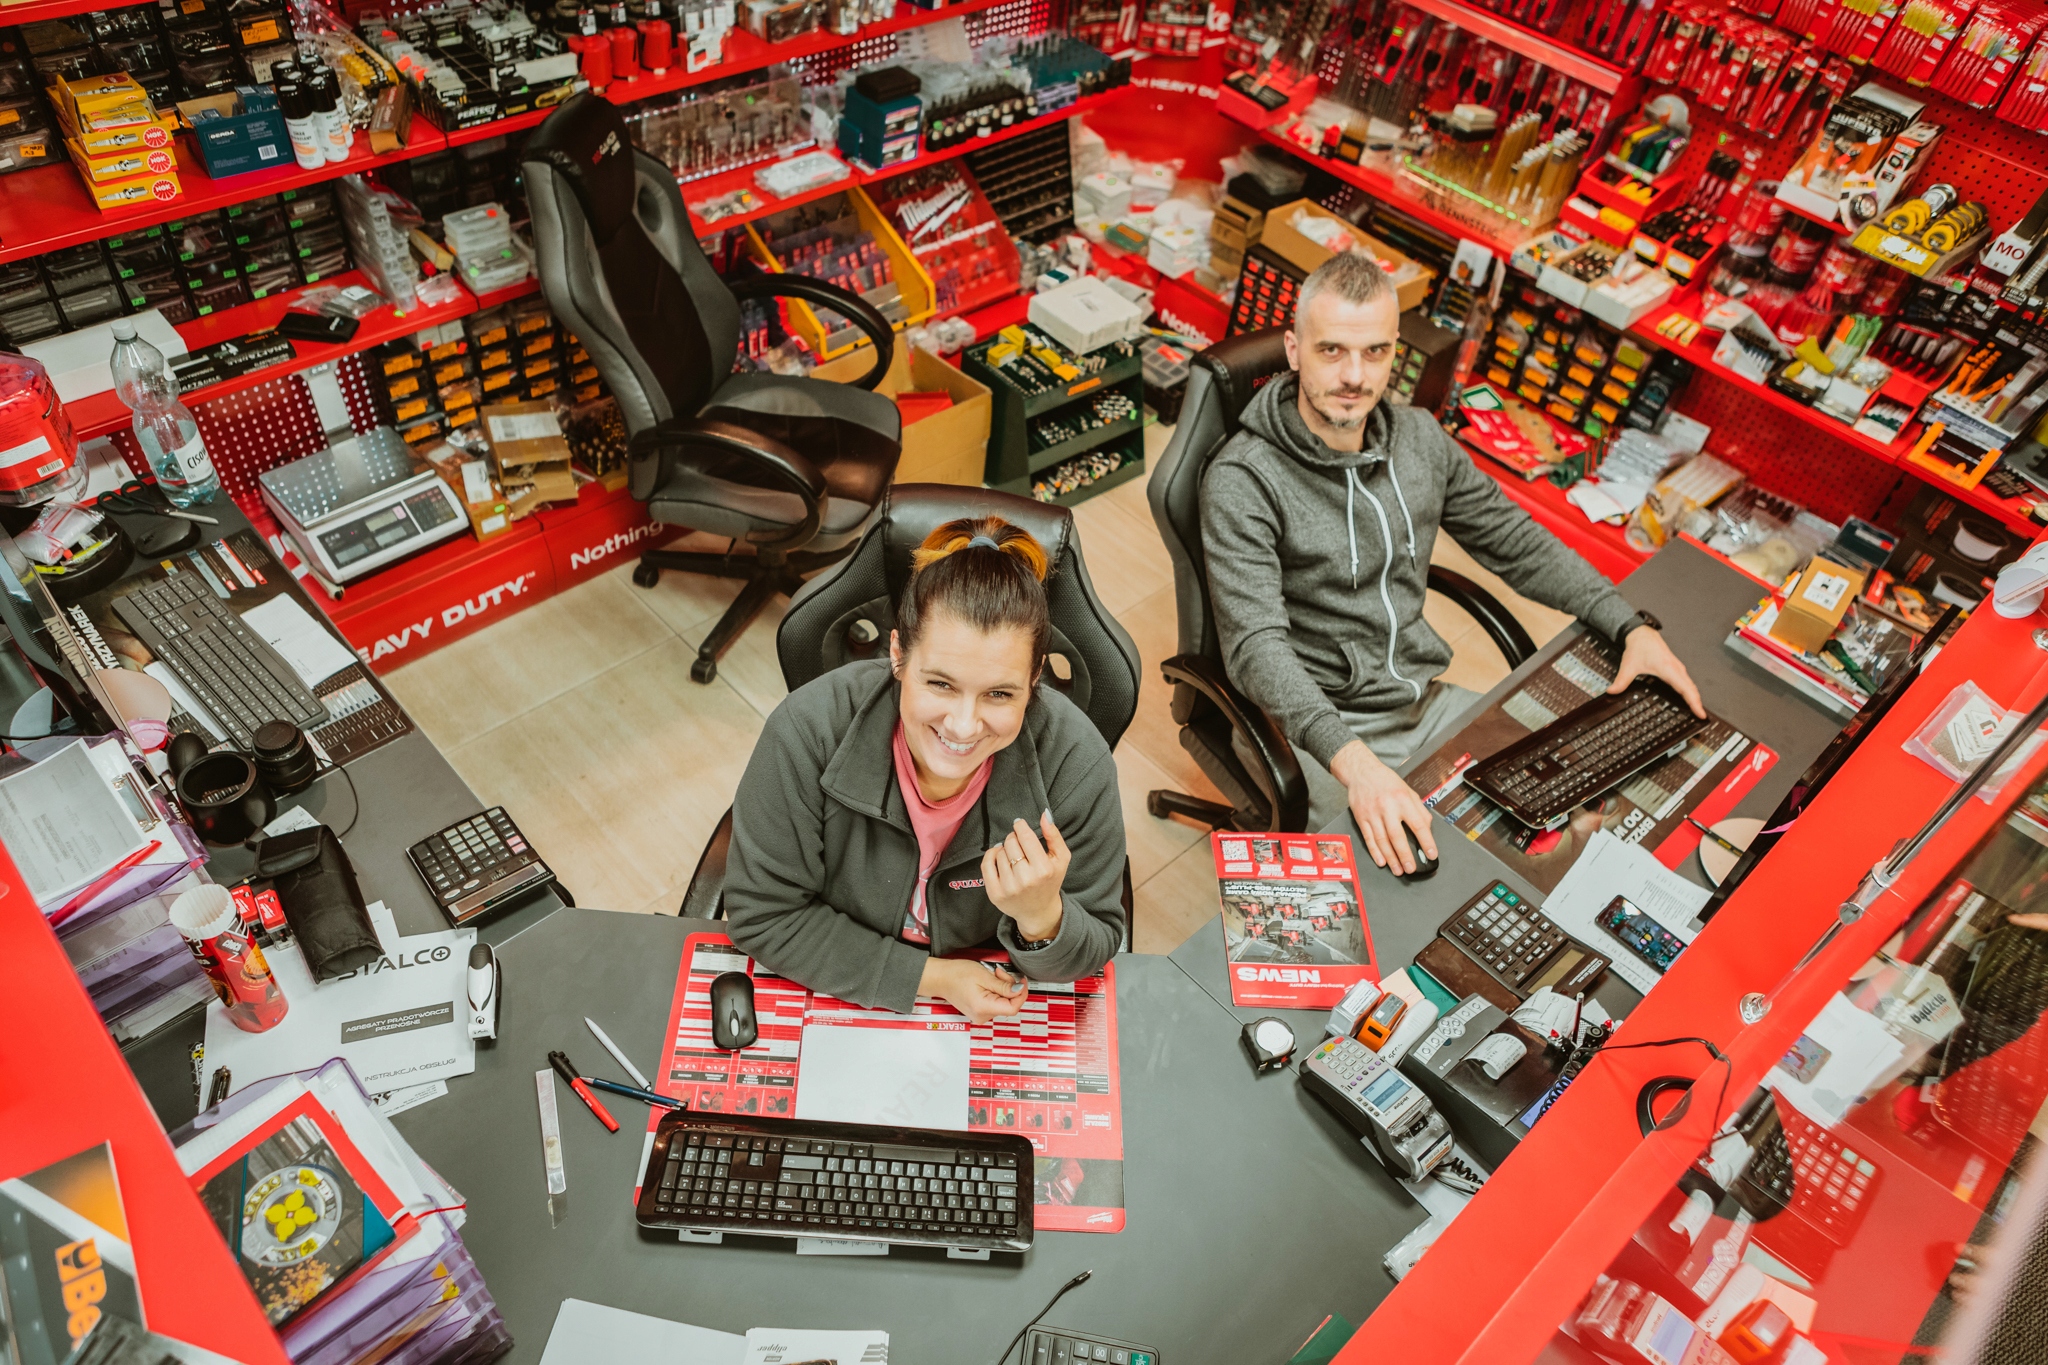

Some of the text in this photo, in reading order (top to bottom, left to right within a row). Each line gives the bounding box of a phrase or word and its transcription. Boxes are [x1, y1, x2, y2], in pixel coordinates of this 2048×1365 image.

[1149, 78, 1197, 94] HEAVY
[1198, 85, 1220, 100] DU
[457, 103, 497, 120] PERFECT
[146, 131, 163, 140] NGK
[150, 156, 167, 165] NGK
[155, 183, 172, 193] NGK
[187, 448, 207, 469] CISOW
[570, 520, 664, 570] Nothing
[67, 603, 121, 669] YRZYNAREK
[355, 617, 434, 665] EAVY
[1623, 807, 1645, 829] DO
[949, 879, 985, 890] QUA
[1236, 965, 1321, 984] NEWS
[345, 1018, 387, 1033] AGREGATY
[364, 1057, 457, 1082] INSTRUKCJA OBSŁUGI
[757, 1343, 788, 1353] clipper
